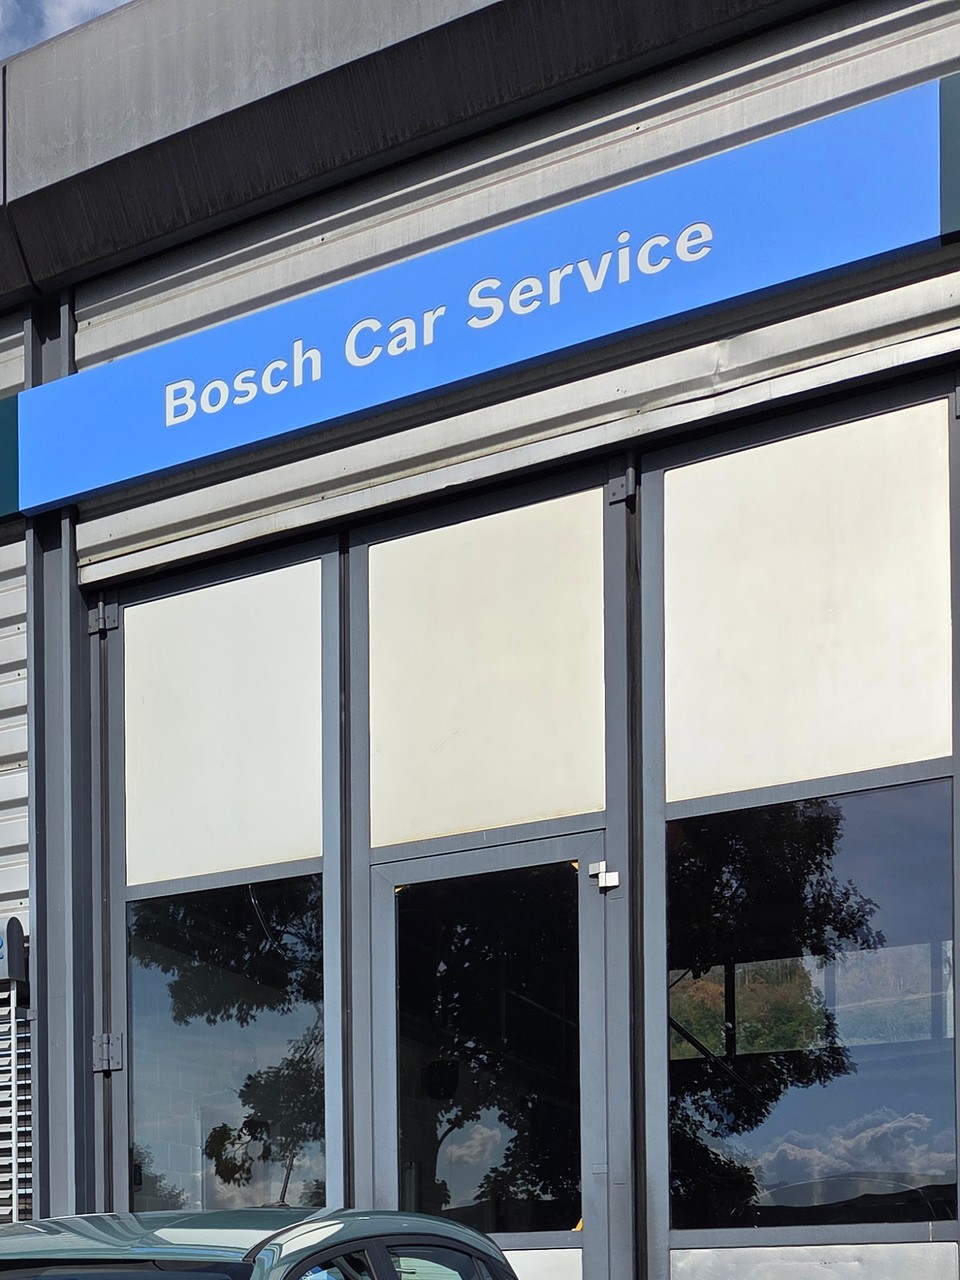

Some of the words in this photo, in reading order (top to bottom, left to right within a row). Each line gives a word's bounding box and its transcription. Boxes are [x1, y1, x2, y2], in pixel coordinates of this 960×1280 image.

[164, 338, 322, 427] Bosch
[344, 303, 446, 368] Car
[466, 221, 714, 329] Service
